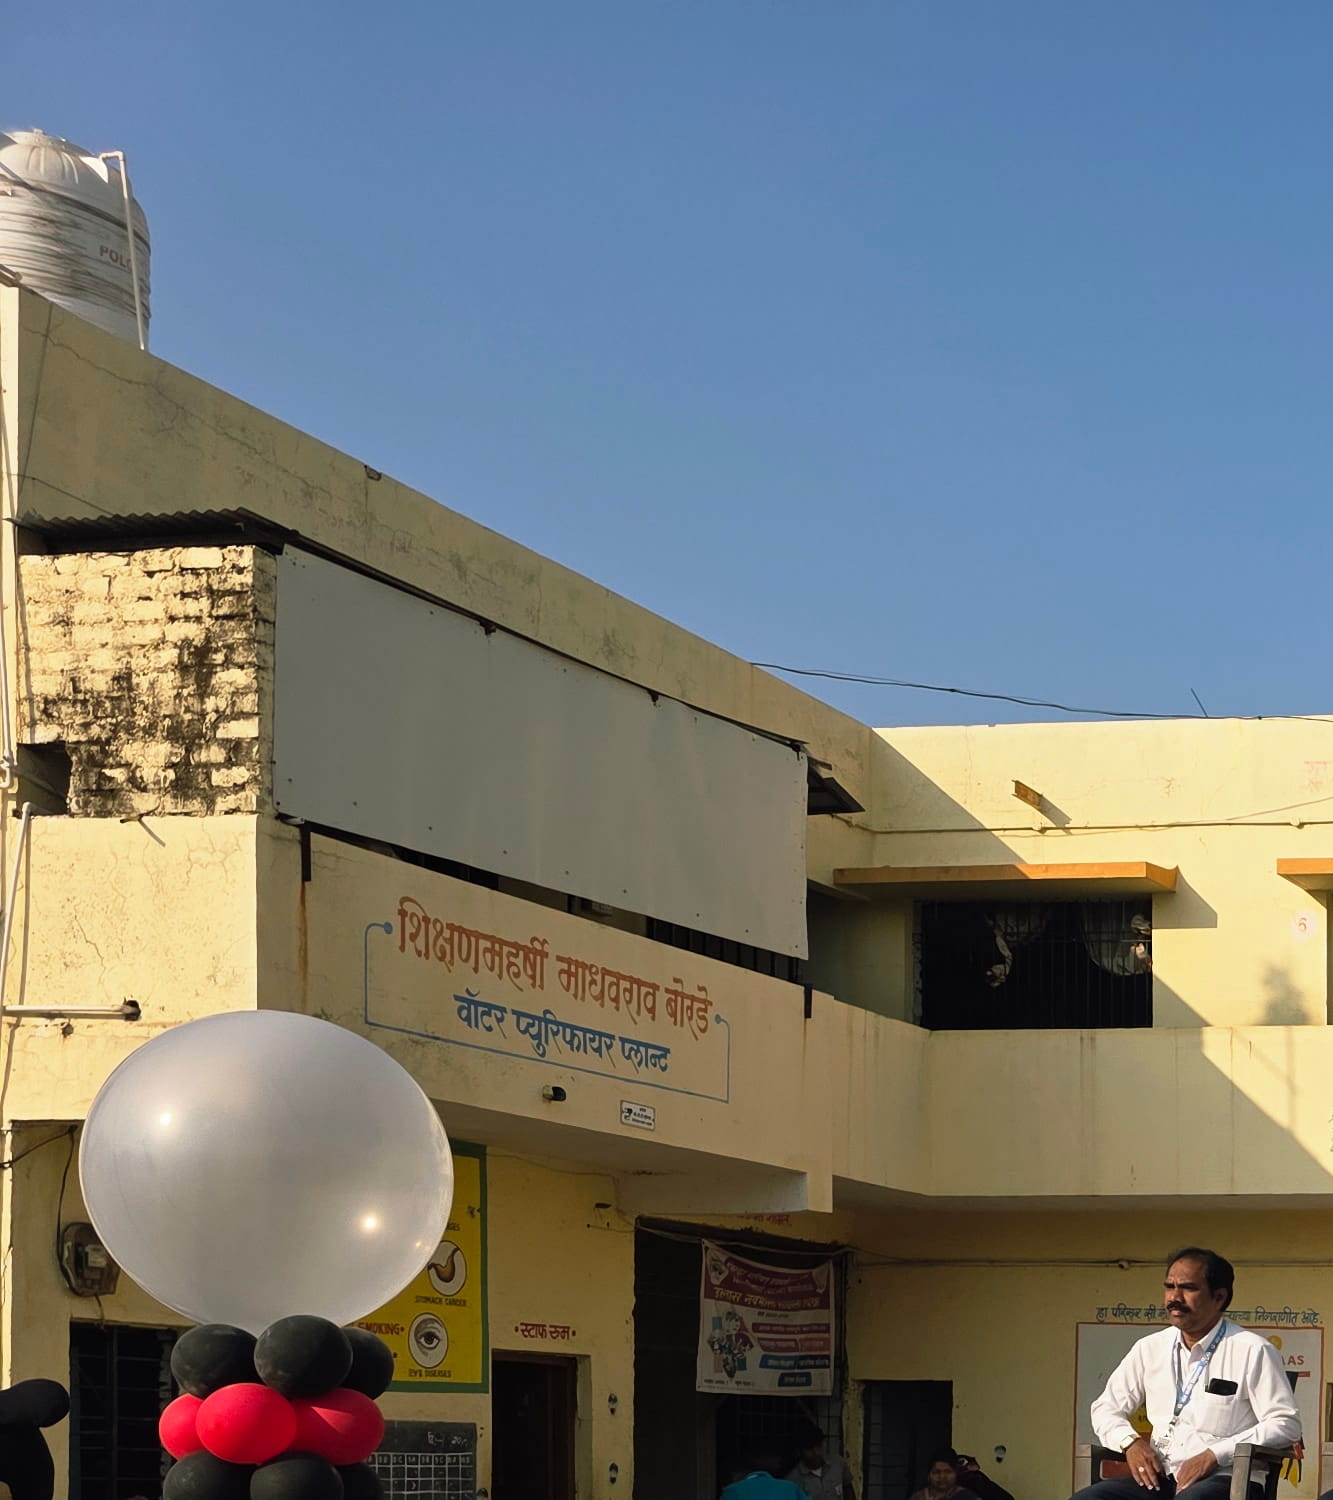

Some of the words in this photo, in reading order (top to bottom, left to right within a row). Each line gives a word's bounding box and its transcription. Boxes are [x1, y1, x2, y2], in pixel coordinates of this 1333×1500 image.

[398, 896, 549, 991] शिक्षणमहर्षी
[557, 955, 660, 1023] माधवराव
[454, 988, 506, 1036] वॉटर
[512, 1008, 616, 1069] प्युरिफायर
[621, 1037, 671, 1074] प्लान्ट
[520, 1322, 547, 1340] स्टाफ
